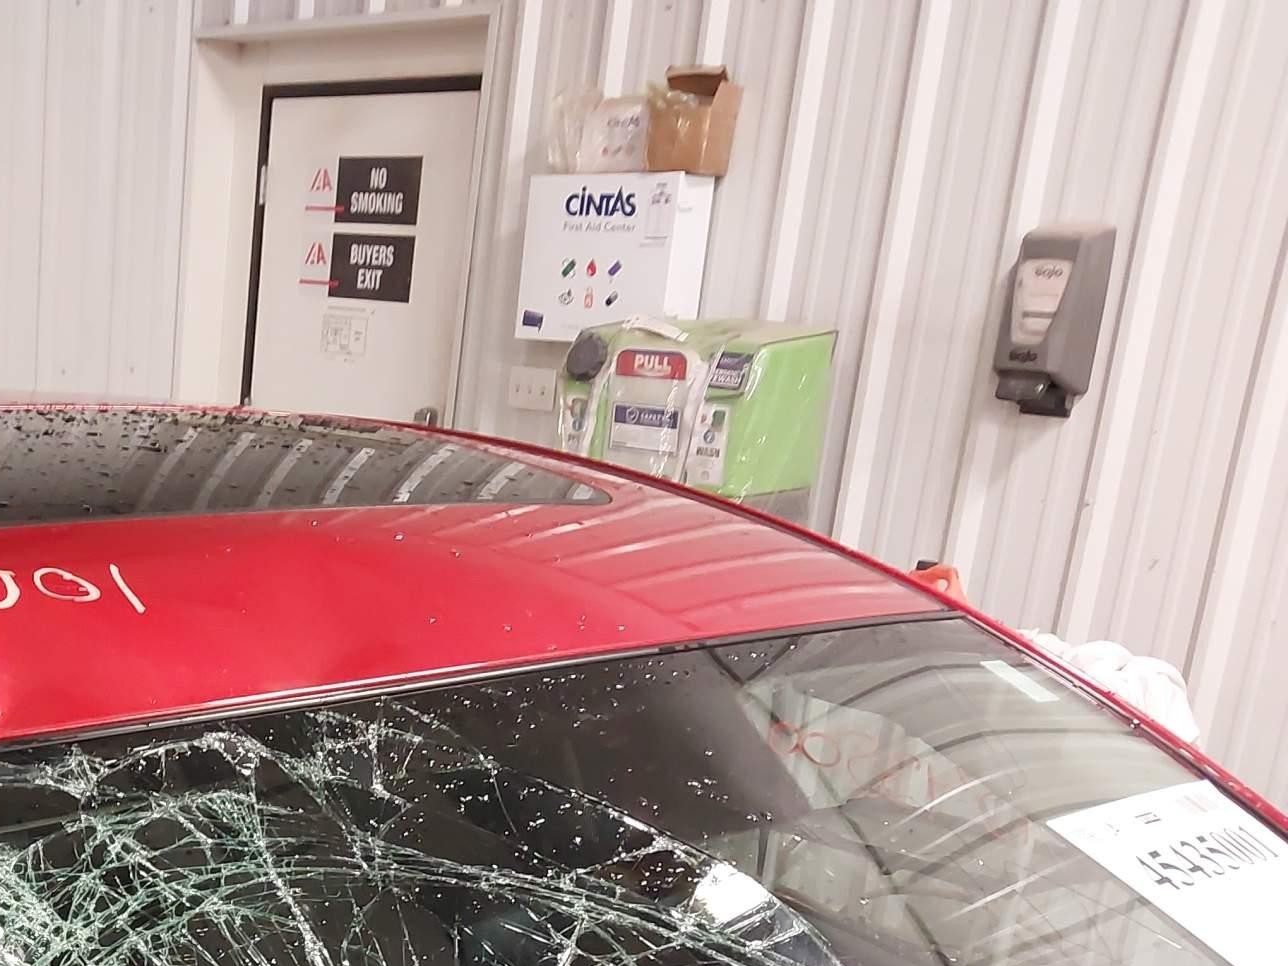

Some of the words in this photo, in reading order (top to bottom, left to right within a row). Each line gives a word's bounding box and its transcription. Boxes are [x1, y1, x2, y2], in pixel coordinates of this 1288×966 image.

[369, 167, 388, 189] NO
[350, 192, 404, 214] SMOKING
[562, 221, 583, 232] First
[585, 221, 602, 232] Aid
[603, 221, 636, 232] Center
[350, 244, 394, 267] BUYERS
[357, 269, 383, 290] EXIT
[633, 354, 672, 370] PULL
[1135, 825, 1280, 890] 45435001
